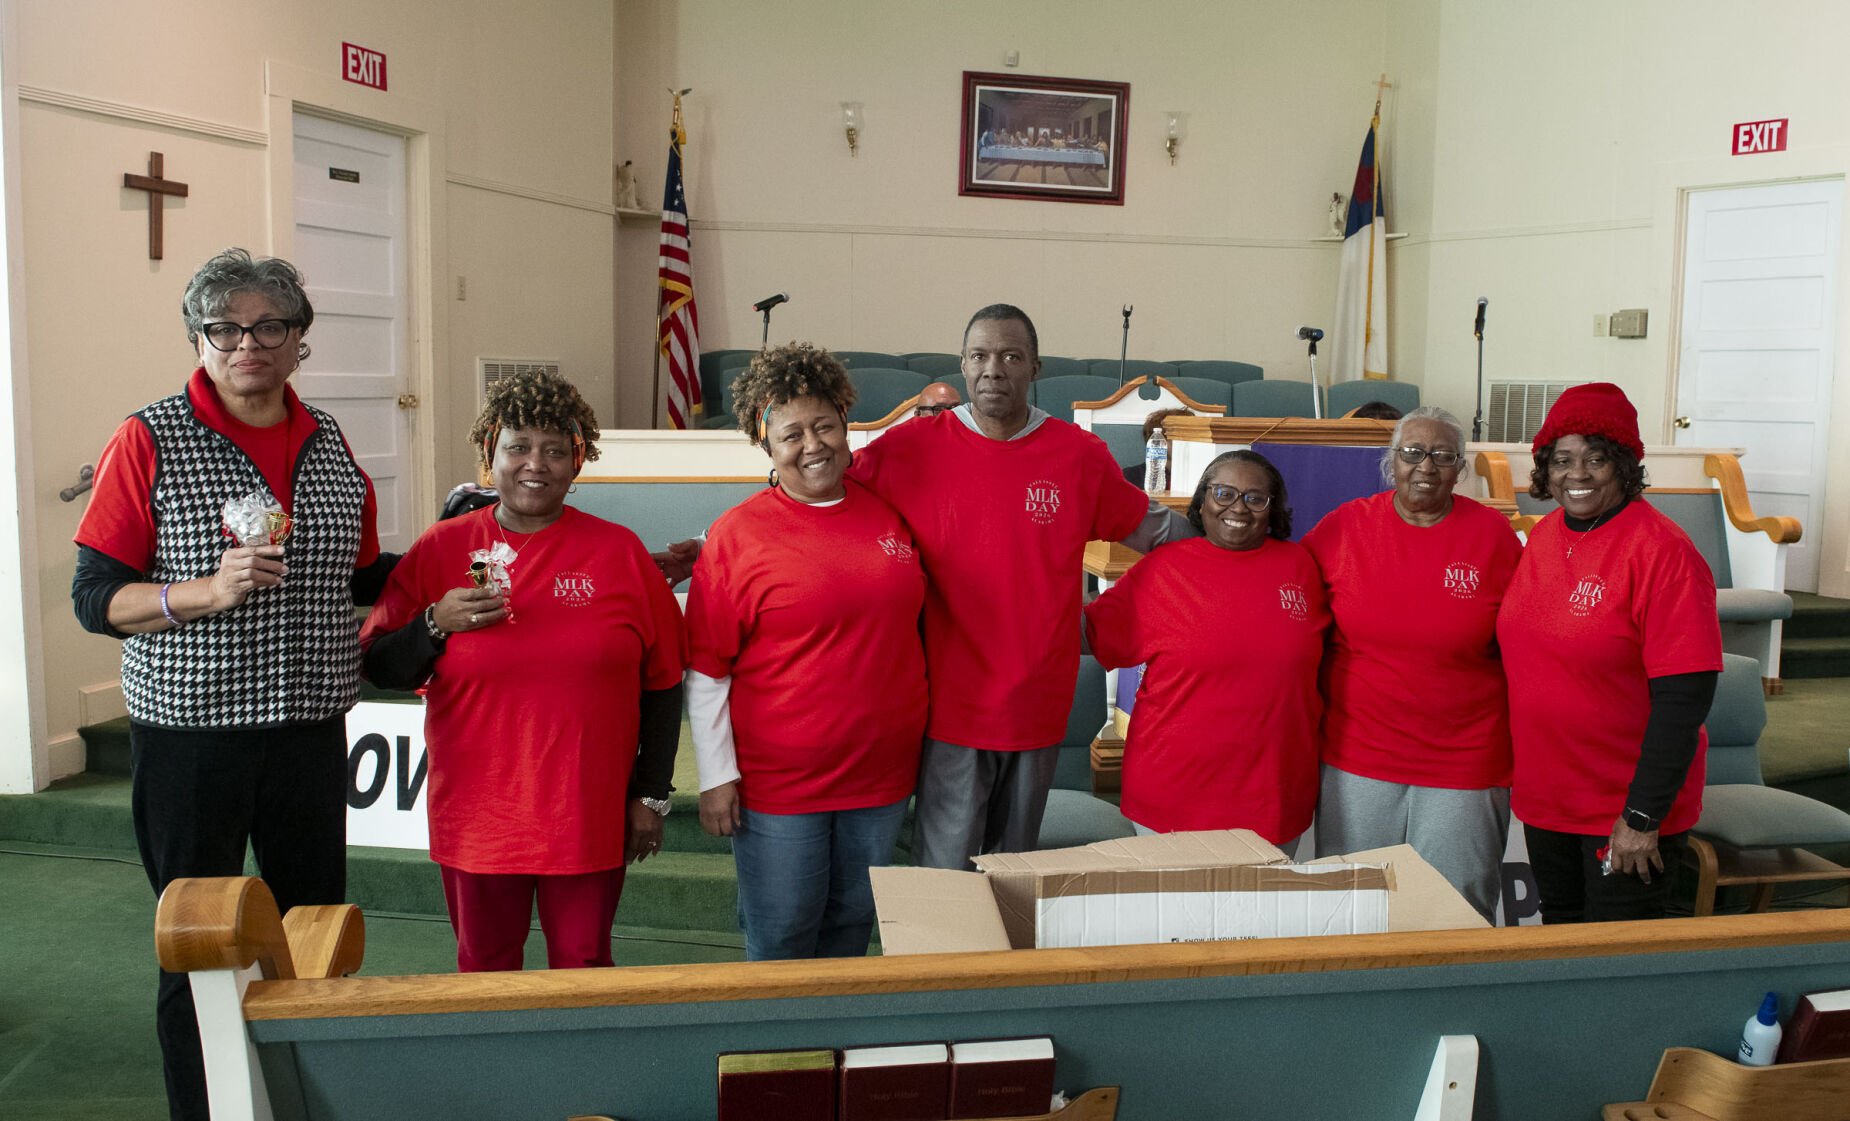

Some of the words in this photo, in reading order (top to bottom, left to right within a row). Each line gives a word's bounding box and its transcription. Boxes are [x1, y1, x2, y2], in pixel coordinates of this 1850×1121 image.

[347, 46, 382, 87] EXIT
[1738, 121, 1782, 153] EXIT
[1025, 488, 1060, 504] MLK
[1025, 501, 1060, 513] DAY
[1444, 568, 1480, 582] MLK
[553, 577, 594, 590] MLK
[1444, 579, 1479, 590] DAY
[1572, 581, 1606, 600] MLK
[554, 589, 596, 598] DAY
[1279, 589, 1307, 605] MLK
[1569, 593, 1602, 607] DAY
[1281, 601, 1308, 613] DAY
[977, 1087, 998, 1096] Holy
